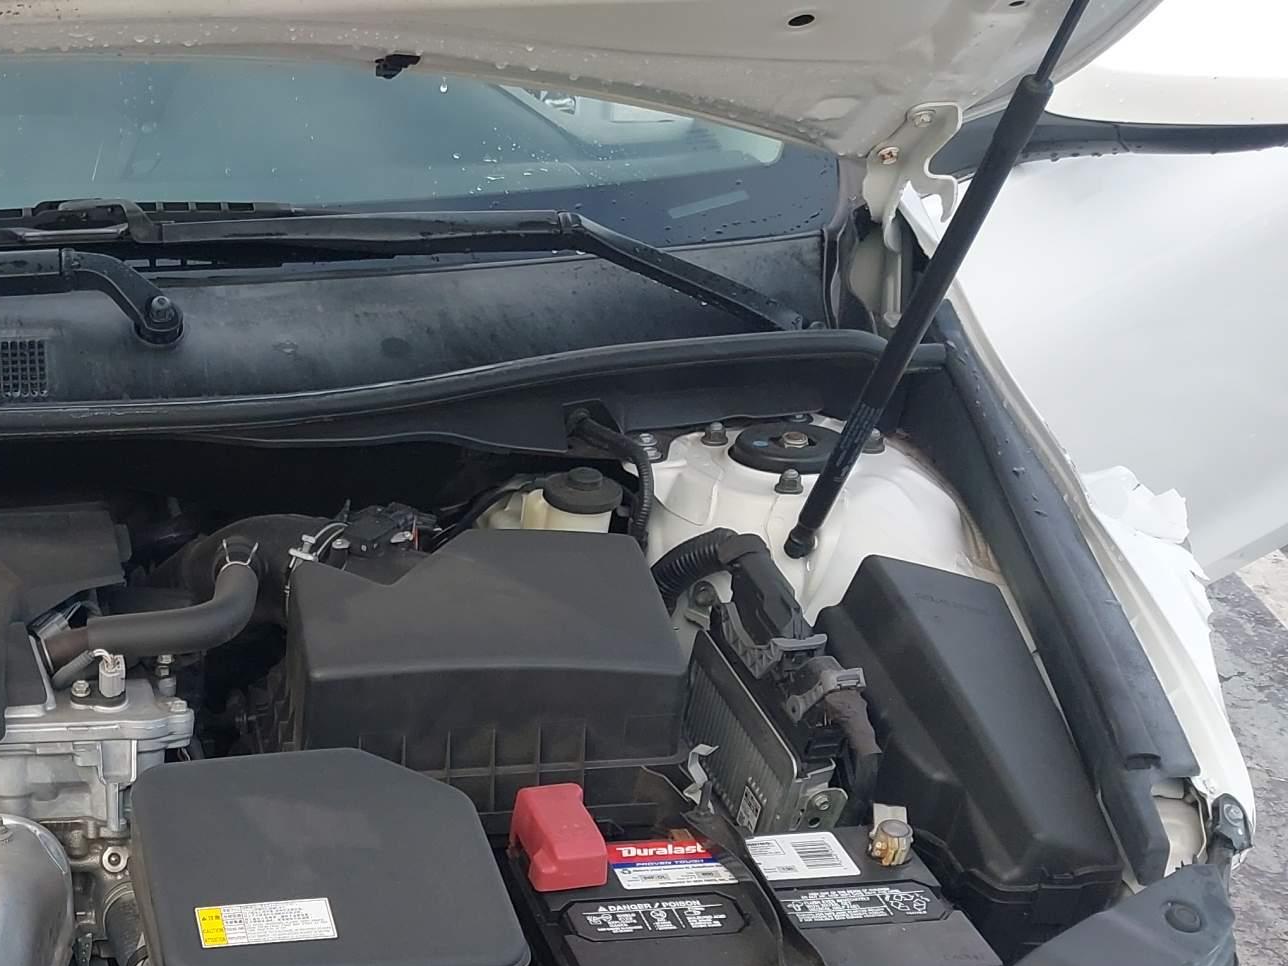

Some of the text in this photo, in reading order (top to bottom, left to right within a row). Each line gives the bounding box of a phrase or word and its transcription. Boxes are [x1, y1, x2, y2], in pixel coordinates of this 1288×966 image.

[616, 842, 707, 858] Duralast
[608, 902, 651, 912] DANGER
[662, 900, 701, 909] POISON
